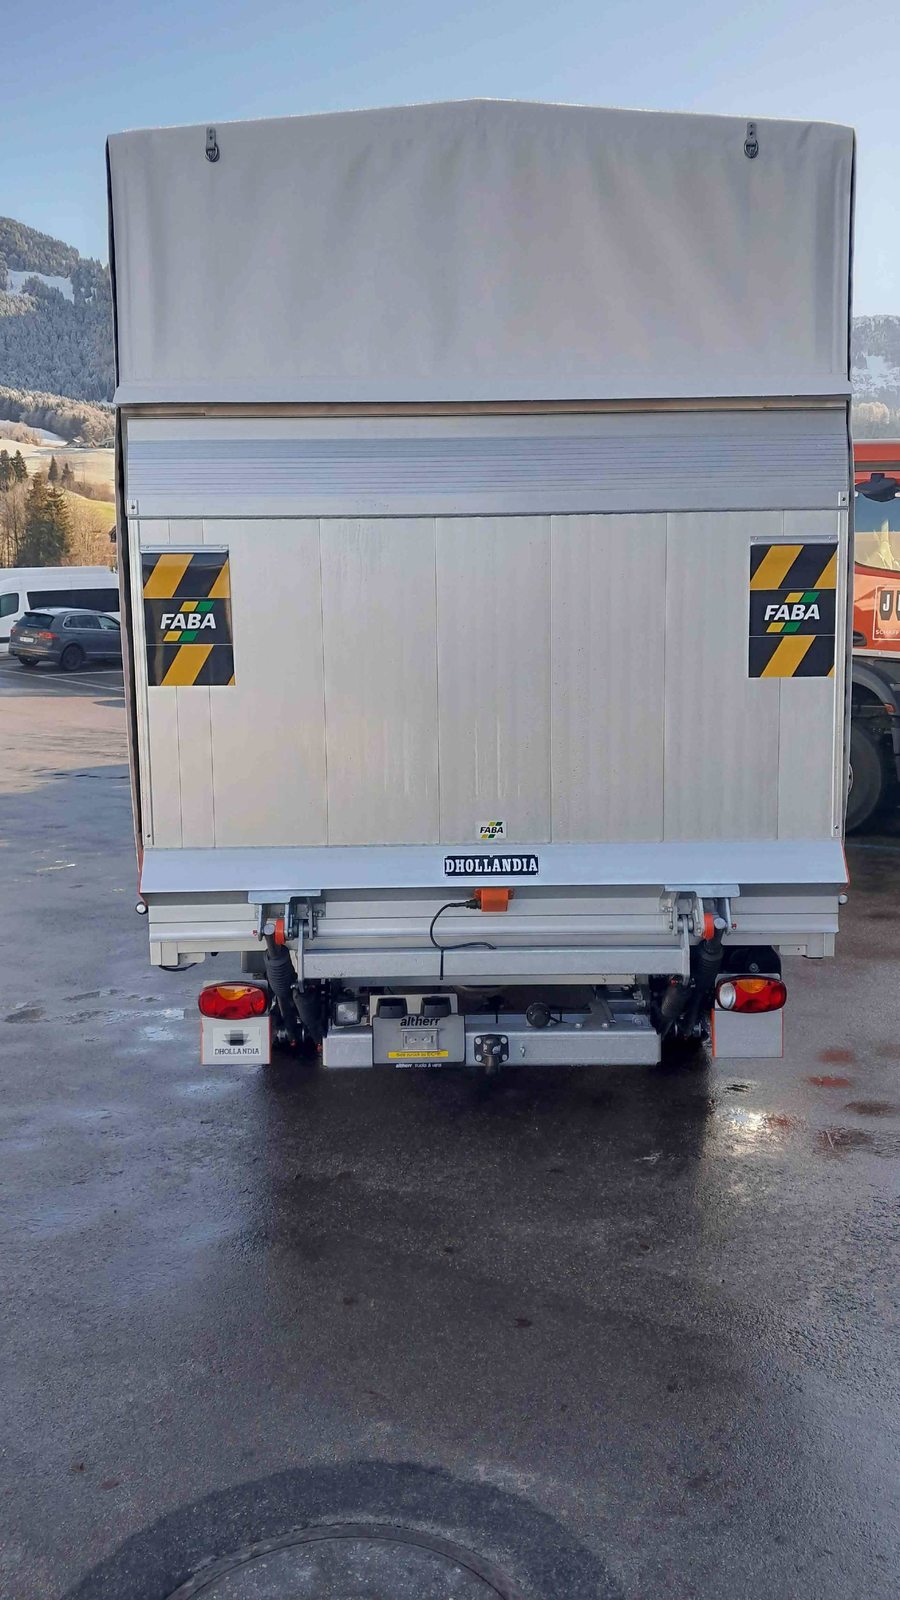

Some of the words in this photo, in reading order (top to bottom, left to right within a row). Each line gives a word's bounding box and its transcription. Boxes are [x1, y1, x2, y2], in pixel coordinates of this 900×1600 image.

[763, 604, 820, 621] FABA
[160, 613, 216, 630] FABA
[480, 826, 504, 834] FABA
[445, 857, 538, 873] DHOLLANDIA
[400, 1016, 440, 1027] altherr
[214, 1047, 260, 1056] DHOLLANDIA
